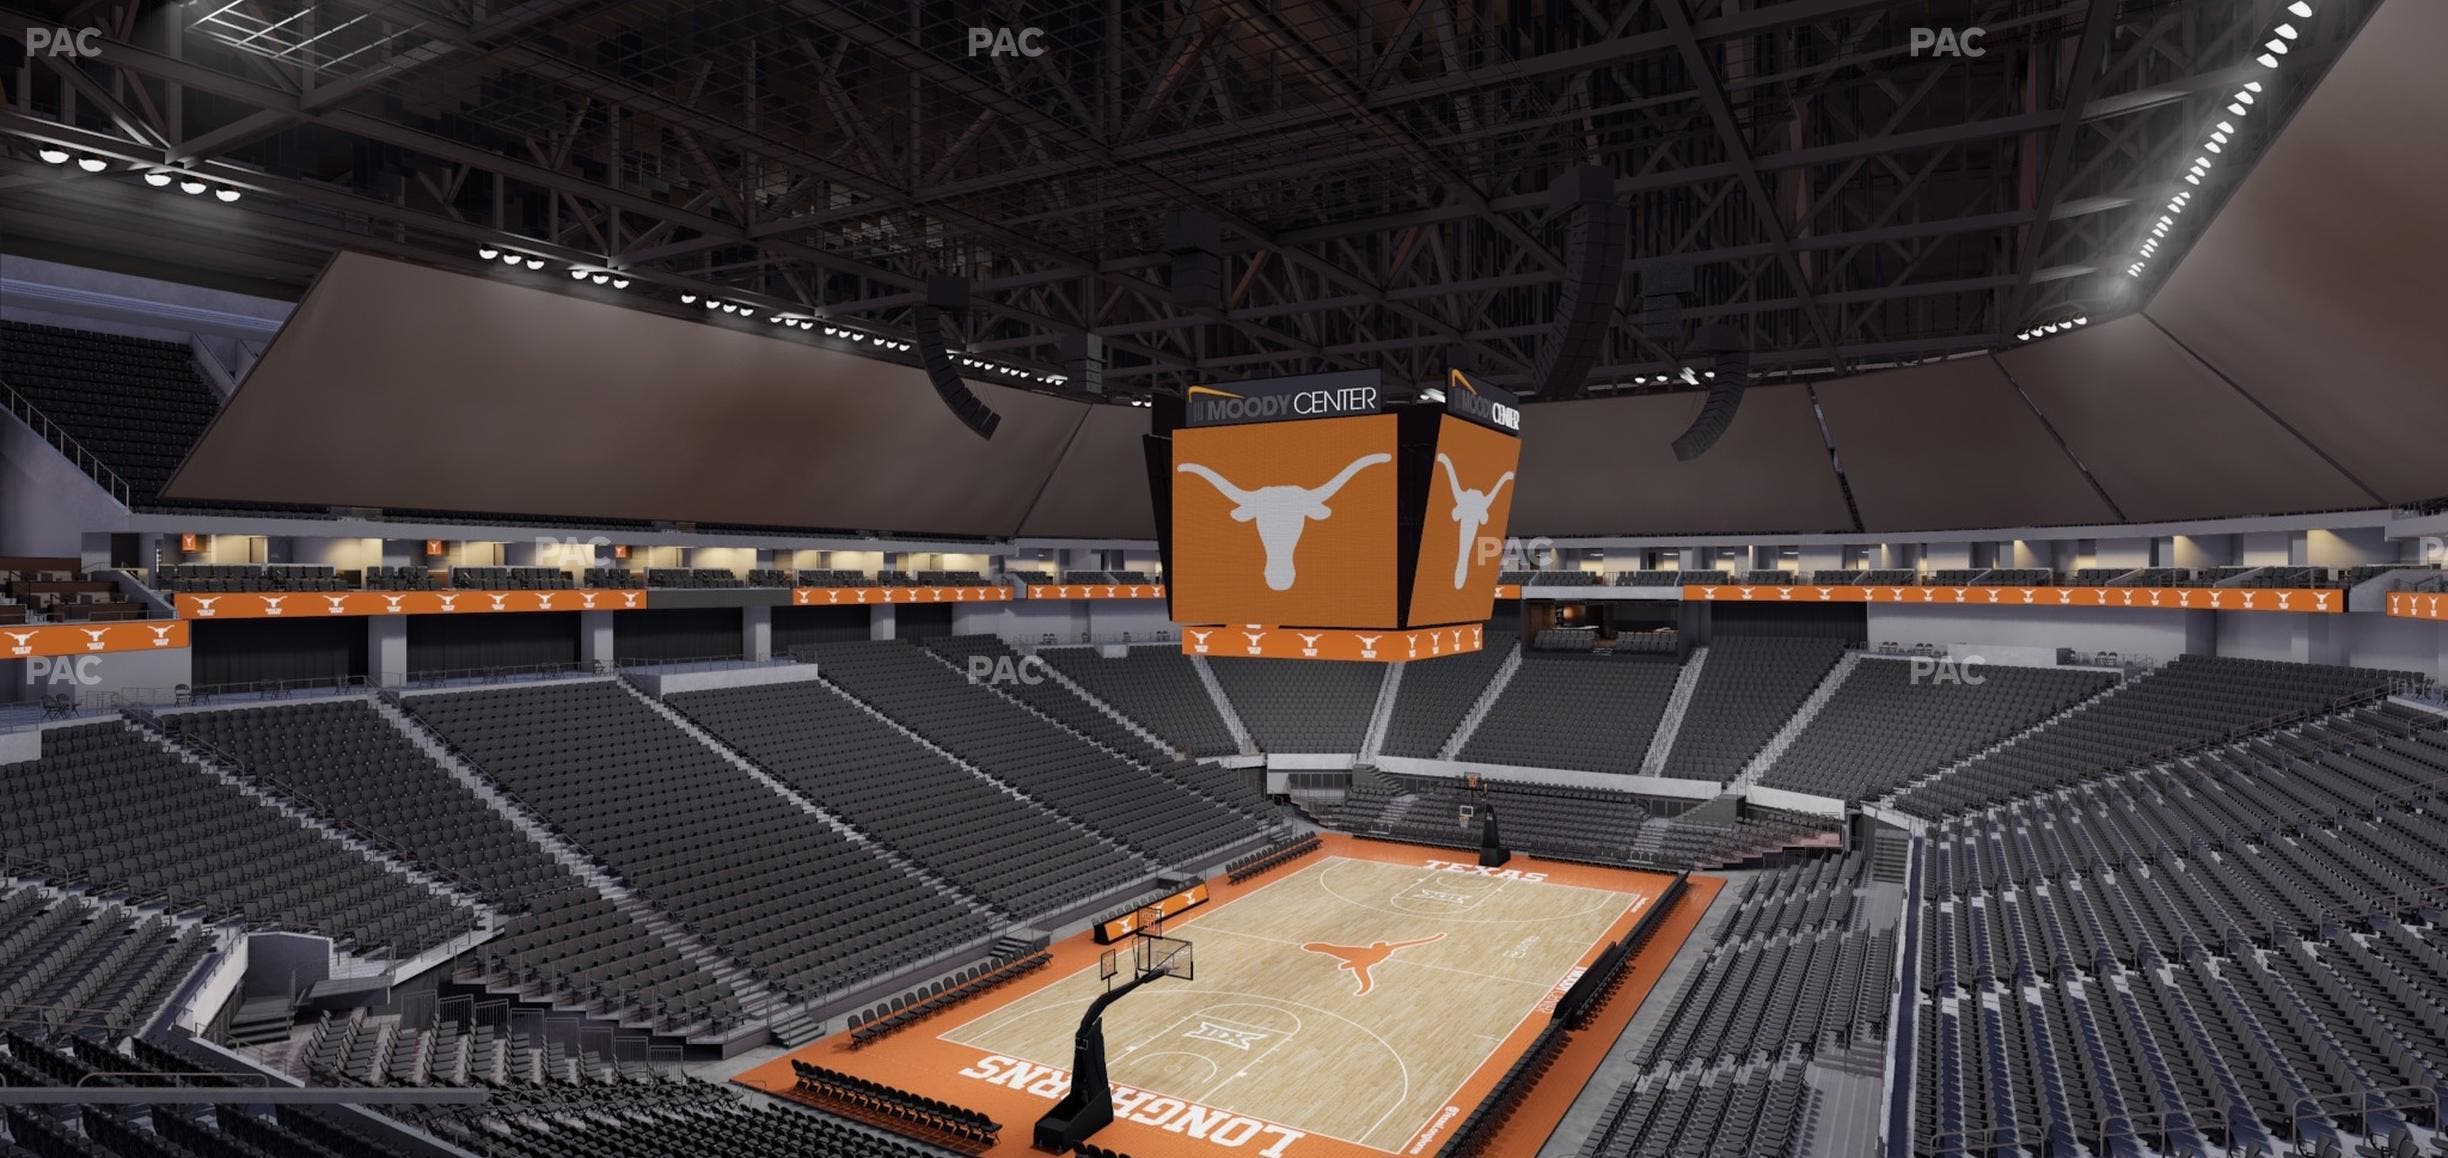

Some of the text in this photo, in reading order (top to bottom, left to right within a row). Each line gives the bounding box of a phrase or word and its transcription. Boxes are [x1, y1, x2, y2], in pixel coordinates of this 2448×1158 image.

[1207, 386, 1376, 421] MOODY CENTER
[1492, 402, 1520, 430] CENTER
[1425, 859, 1549, 882] TEXAS
[957, 1054, 1307, 1158] LONGHRNS
